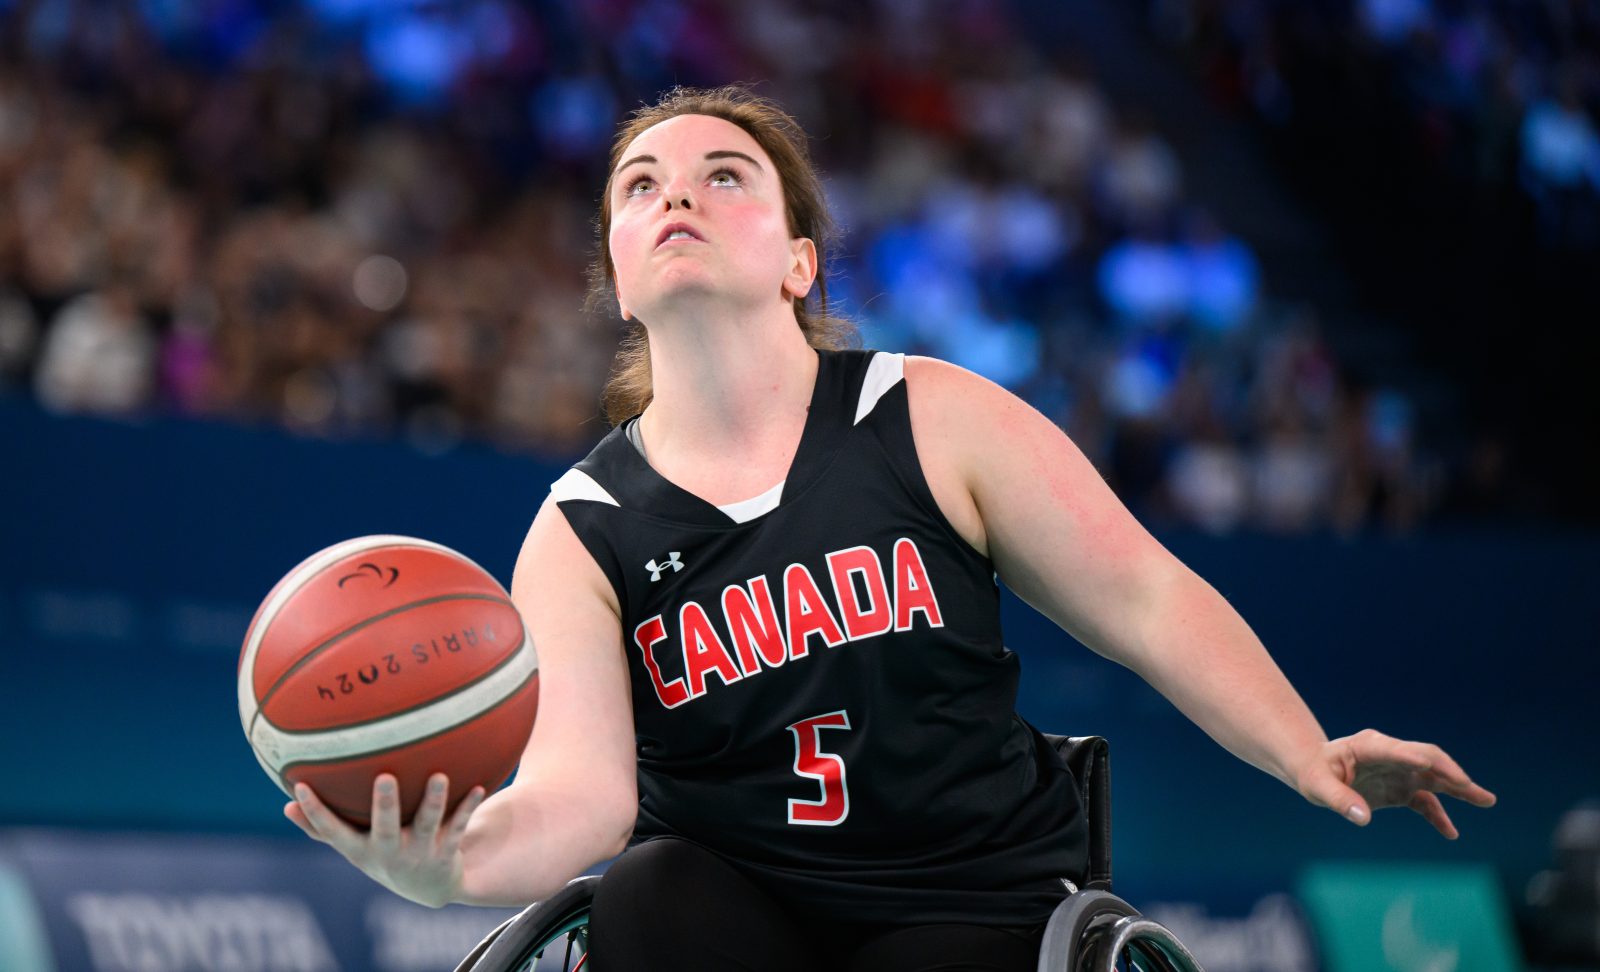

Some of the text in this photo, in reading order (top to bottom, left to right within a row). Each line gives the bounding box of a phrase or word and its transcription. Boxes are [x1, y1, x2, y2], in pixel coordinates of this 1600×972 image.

[316, 623, 496, 701] PARIS 2024
[634, 537, 944, 709] CANADA
[786, 710, 851, 826] 5
